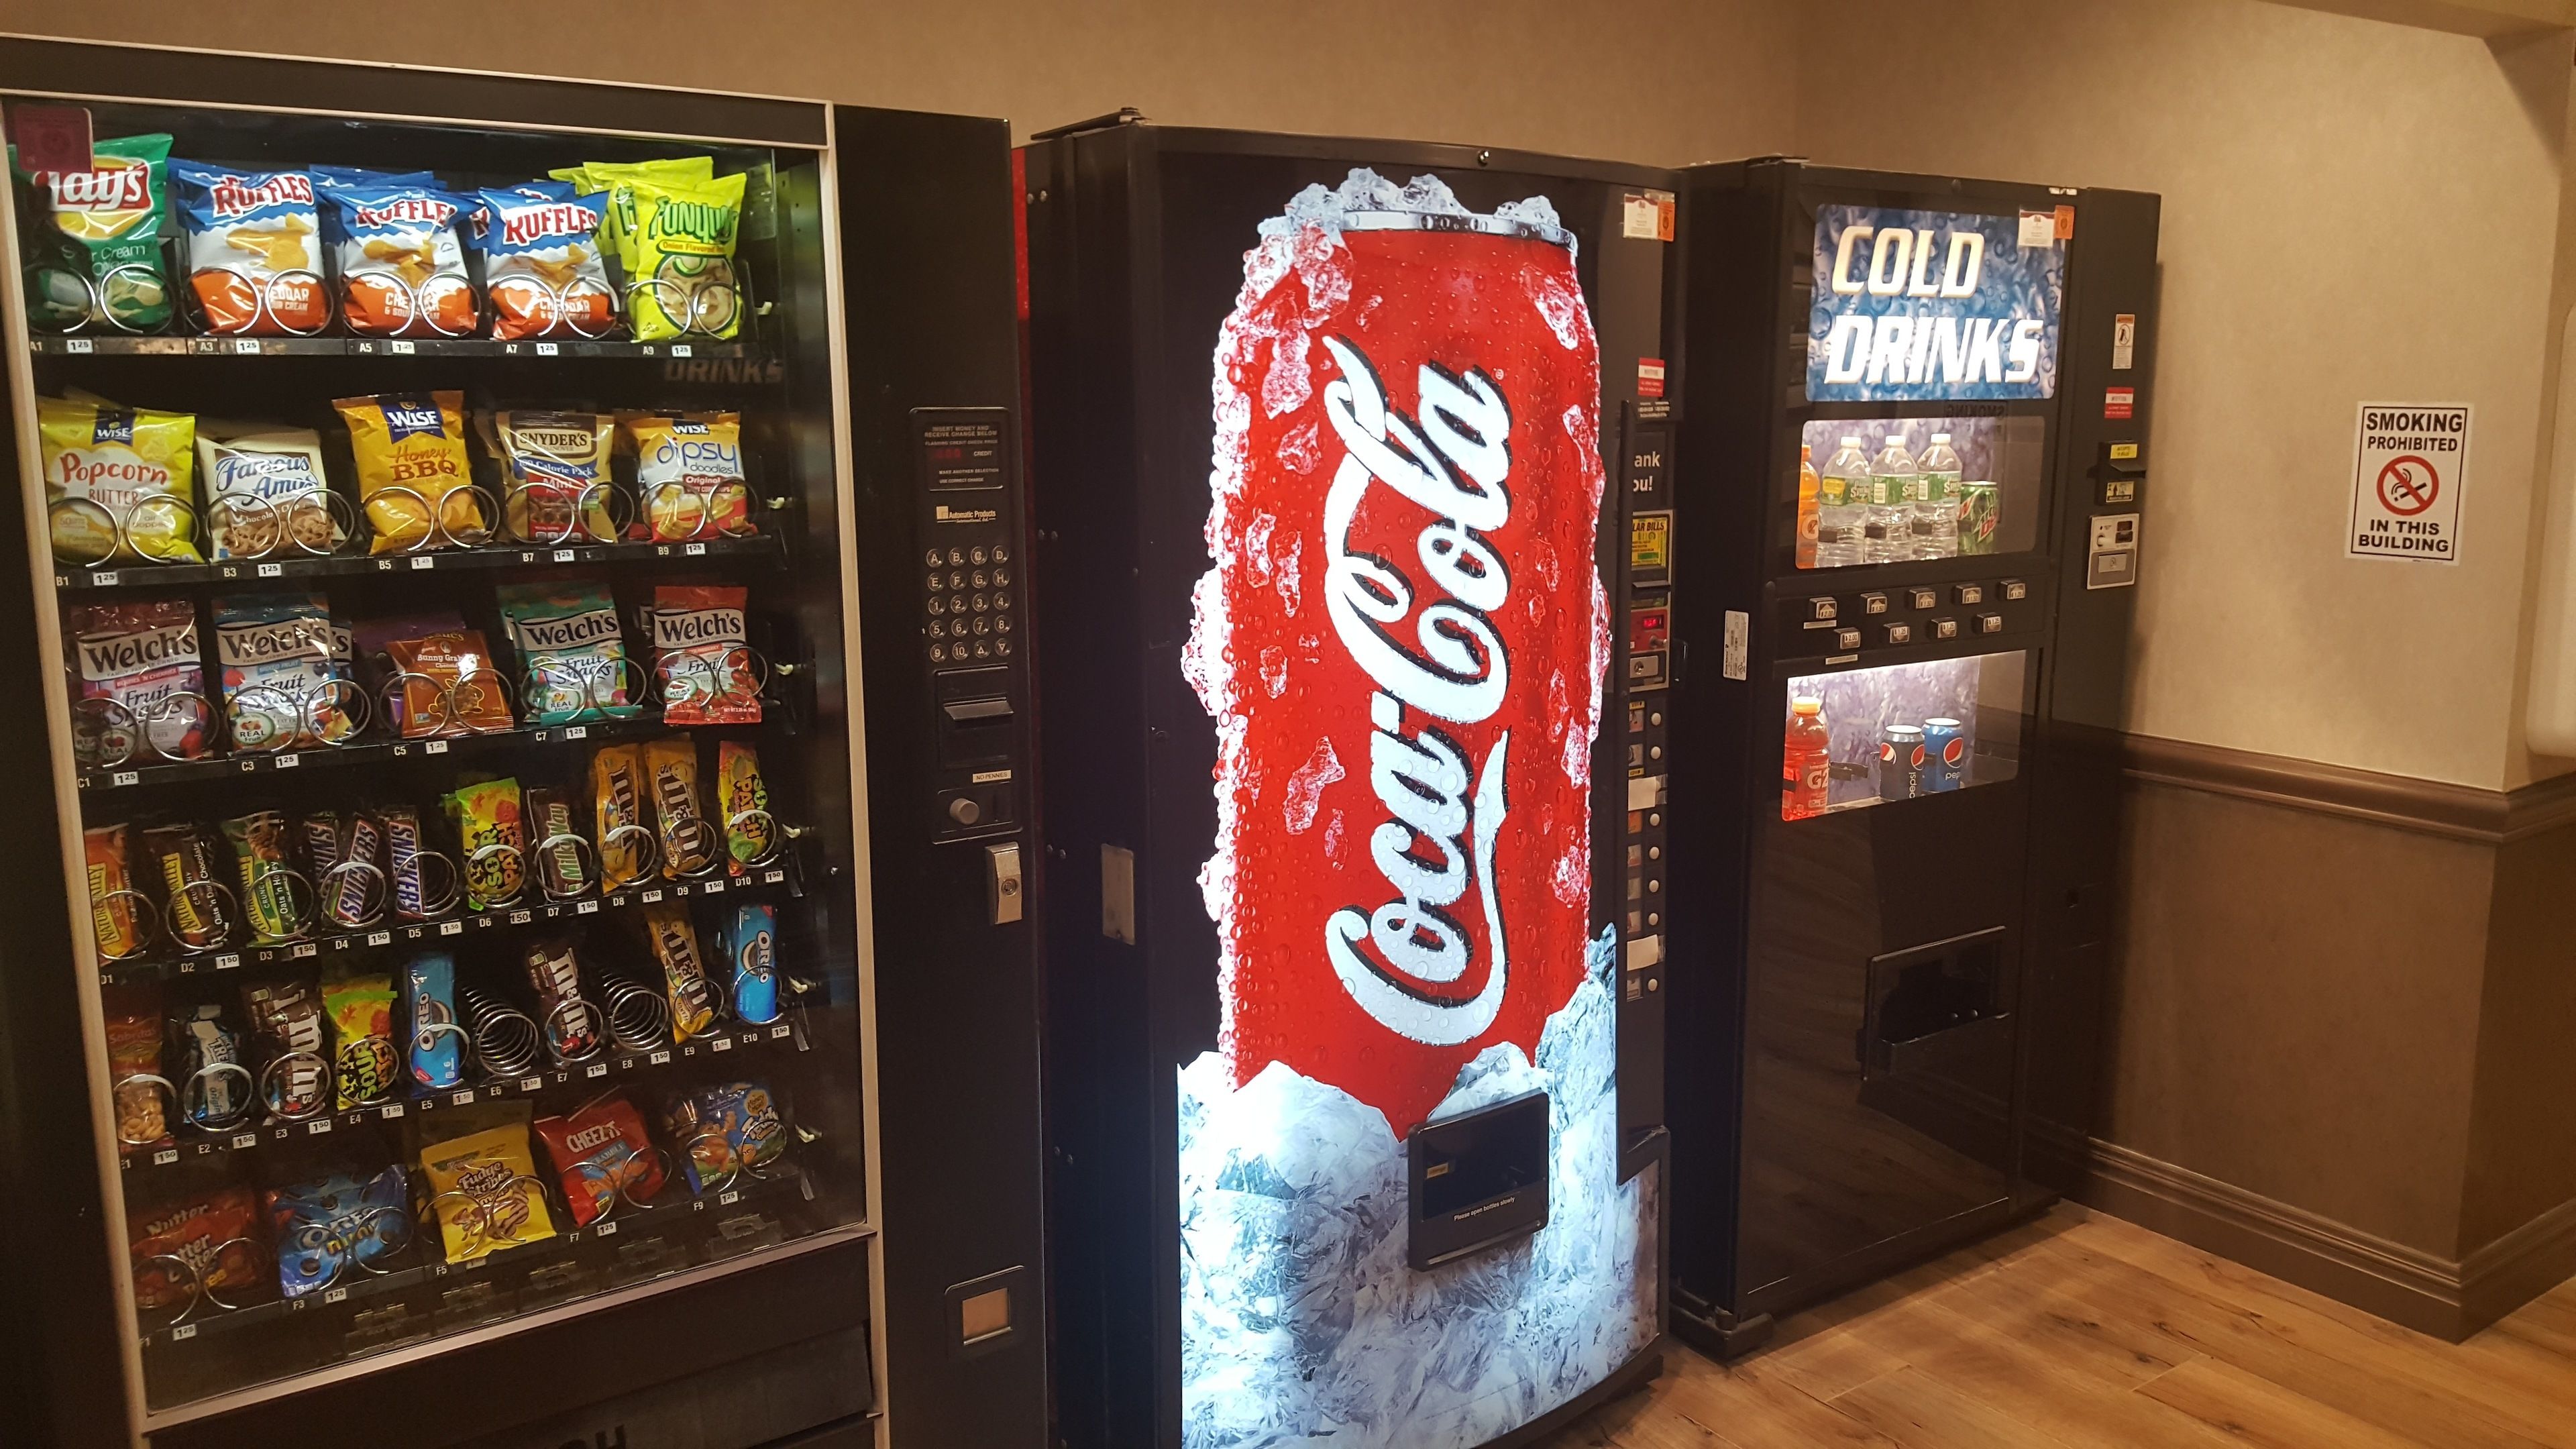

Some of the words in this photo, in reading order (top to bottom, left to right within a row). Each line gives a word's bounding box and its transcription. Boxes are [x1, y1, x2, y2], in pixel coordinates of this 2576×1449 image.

[49, 166, 144, 211] Lay's
[505, 204, 598, 246] RUFFLES
[101, 245, 146, 260] Cream
[1831, 225, 1985, 298] COLD
[200, 341, 214, 352] A3
[359, 343, 372, 353] A5
[505, 344, 518, 355] A7
[642, 345, 655, 356] A9
[1823, 315, 2044, 384] DRINKS
[2366, 412, 2463, 432] SMOKING
[519, 433, 588, 447] SNYDER'S
[2367, 435, 2458, 451] PROHIBITED
[656, 437, 738, 473] dipsy
[1634, 451, 1660, 468] ank
[59, 452, 168, 486] Popcorn
[390, 460, 459, 482] BBQ
[690, 464, 734, 474] doodles
[686, 476, 721, 484] Original
[1633, 476, 1653, 492] ou!
[88, 488, 139, 506] BUTTER
[1632, 522, 1646, 532] LAR
[2370, 519, 2390, 532] IN
[2396, 521, 2440, 535] THIS
[2358, 534, 2449, 552] BUILDING
[657, 547, 669, 555] B9
[522, 553, 534, 562] B7
[378, 561, 391, 570] B5
[223, 568, 237, 578] B3
[56, 575, 70, 586] B1
[524, 614, 618, 645] Welch's
[658, 612, 741, 642] Welch's
[221, 623, 328, 660] Welch's
[85, 632, 198, 674] Welch's
[417, 653, 443, 662] Bunny
[125, 684, 172, 707] Fruit
[1323, 333, 1511, 1048] Coca-Cola
[239, 729, 266, 737] REAL
[535, 731, 547, 741] C7
[394, 746, 407, 756] C5
[241, 761, 254, 771] C3
[985, 771, 1008, 780] PENNIES
[338, 821, 378, 922] SNICKERS
[389, 824, 422, 913] SNICKERS
[735, 876, 751, 886] D10
[677, 886, 689, 896] D9
[612, 897, 625, 906] D8
[547, 907, 559, 917] D7
[478, 918, 492, 927] D6
[408, 929, 422, 938] D5
[335, 940, 348, 950] D4
[259, 951, 273, 961] D3
[180, 963, 195, 973] D2
[417, 991, 436, 1052] OREO
[743, 1034, 758, 1043] E10
[684, 1047, 696, 1057] E9
[622, 1059, 633, 1069] E8
[557, 1073, 568, 1083] E7
[490, 1086, 502, 1096] E6
[421, 1100, 433, 1109] E5
[350, 1114, 362, 1124] E4
[198, 1144, 211, 1153] E2
[458, 1161, 502, 1189] Fudge
[693, 1201, 704, 1211] F9
[1453, 1210, 1470, 1221] Please
[1470, 1208, 1483, 1216] open
[1483, 1203, 1500, 1212] bottles
[1500, 1196, 1515, 1207] slowly
[569, 1232, 580, 1242] F7
[435, 1265, 447, 1275] F5
[292, 1299, 305, 1309] F3
